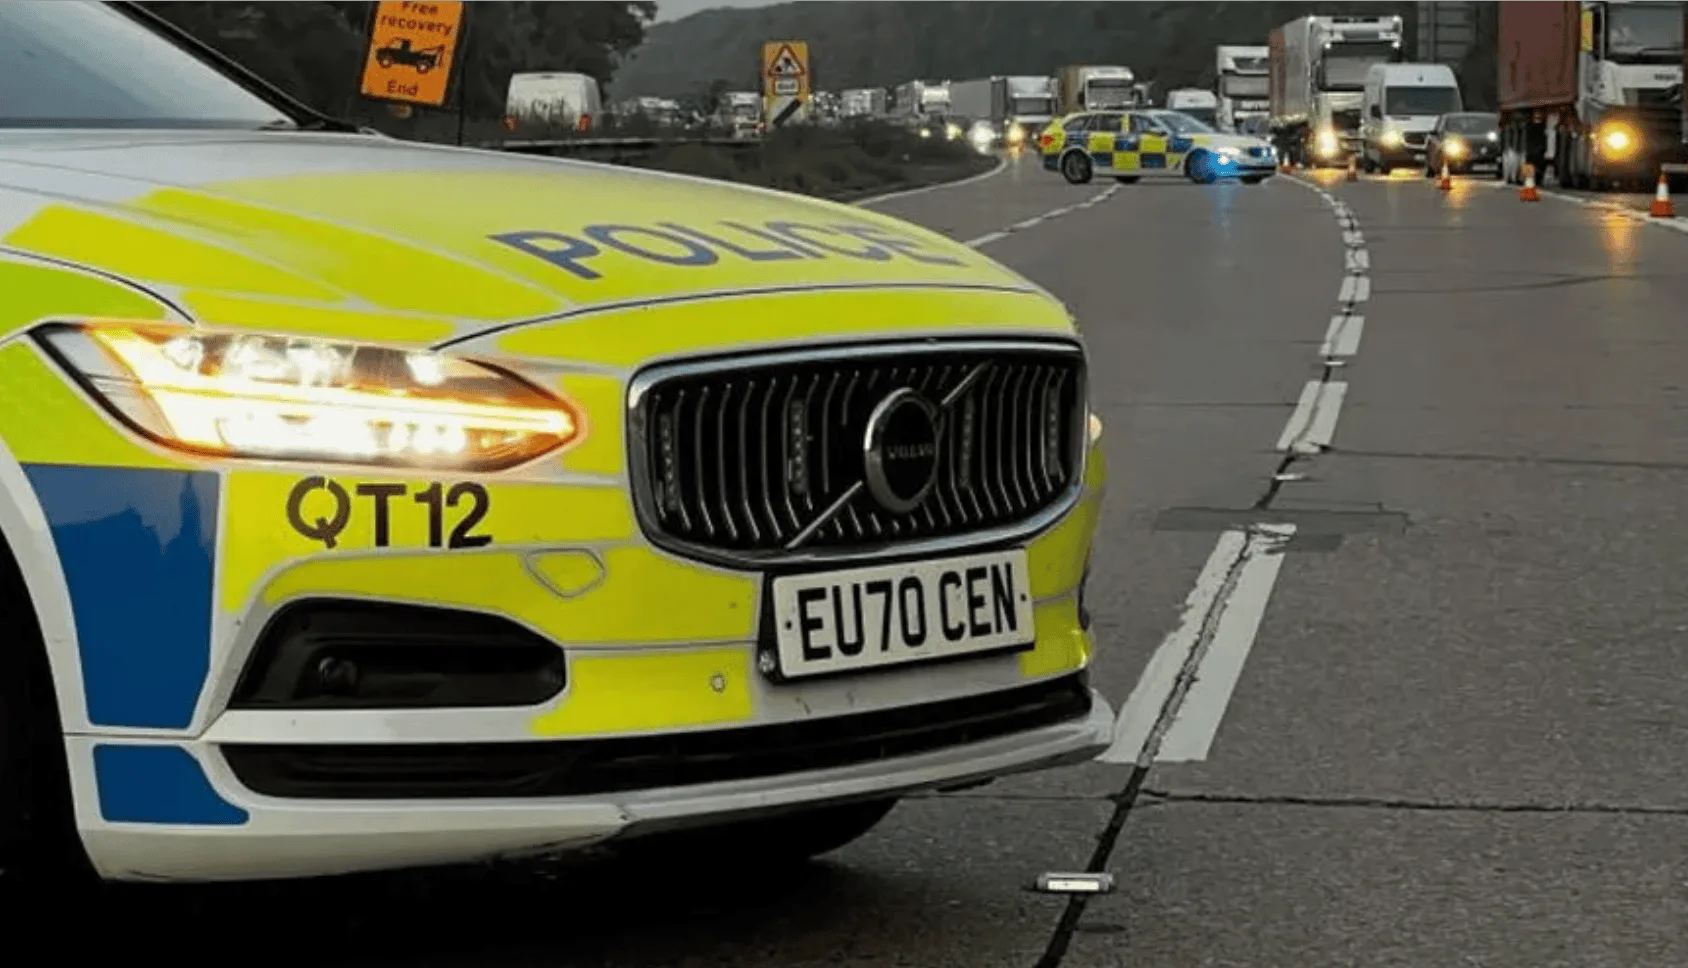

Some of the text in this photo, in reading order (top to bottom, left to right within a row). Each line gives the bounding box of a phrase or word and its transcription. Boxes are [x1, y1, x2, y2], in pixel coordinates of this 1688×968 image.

[381, 15, 452, 36] recovery
[401, 1, 439, 15] Free
[387, 79, 420, 96] End
[487, 219, 968, 280] POLICE
[286, 475, 493, 549] QT12
[797, 561, 1018, 661] EU70 CEN
